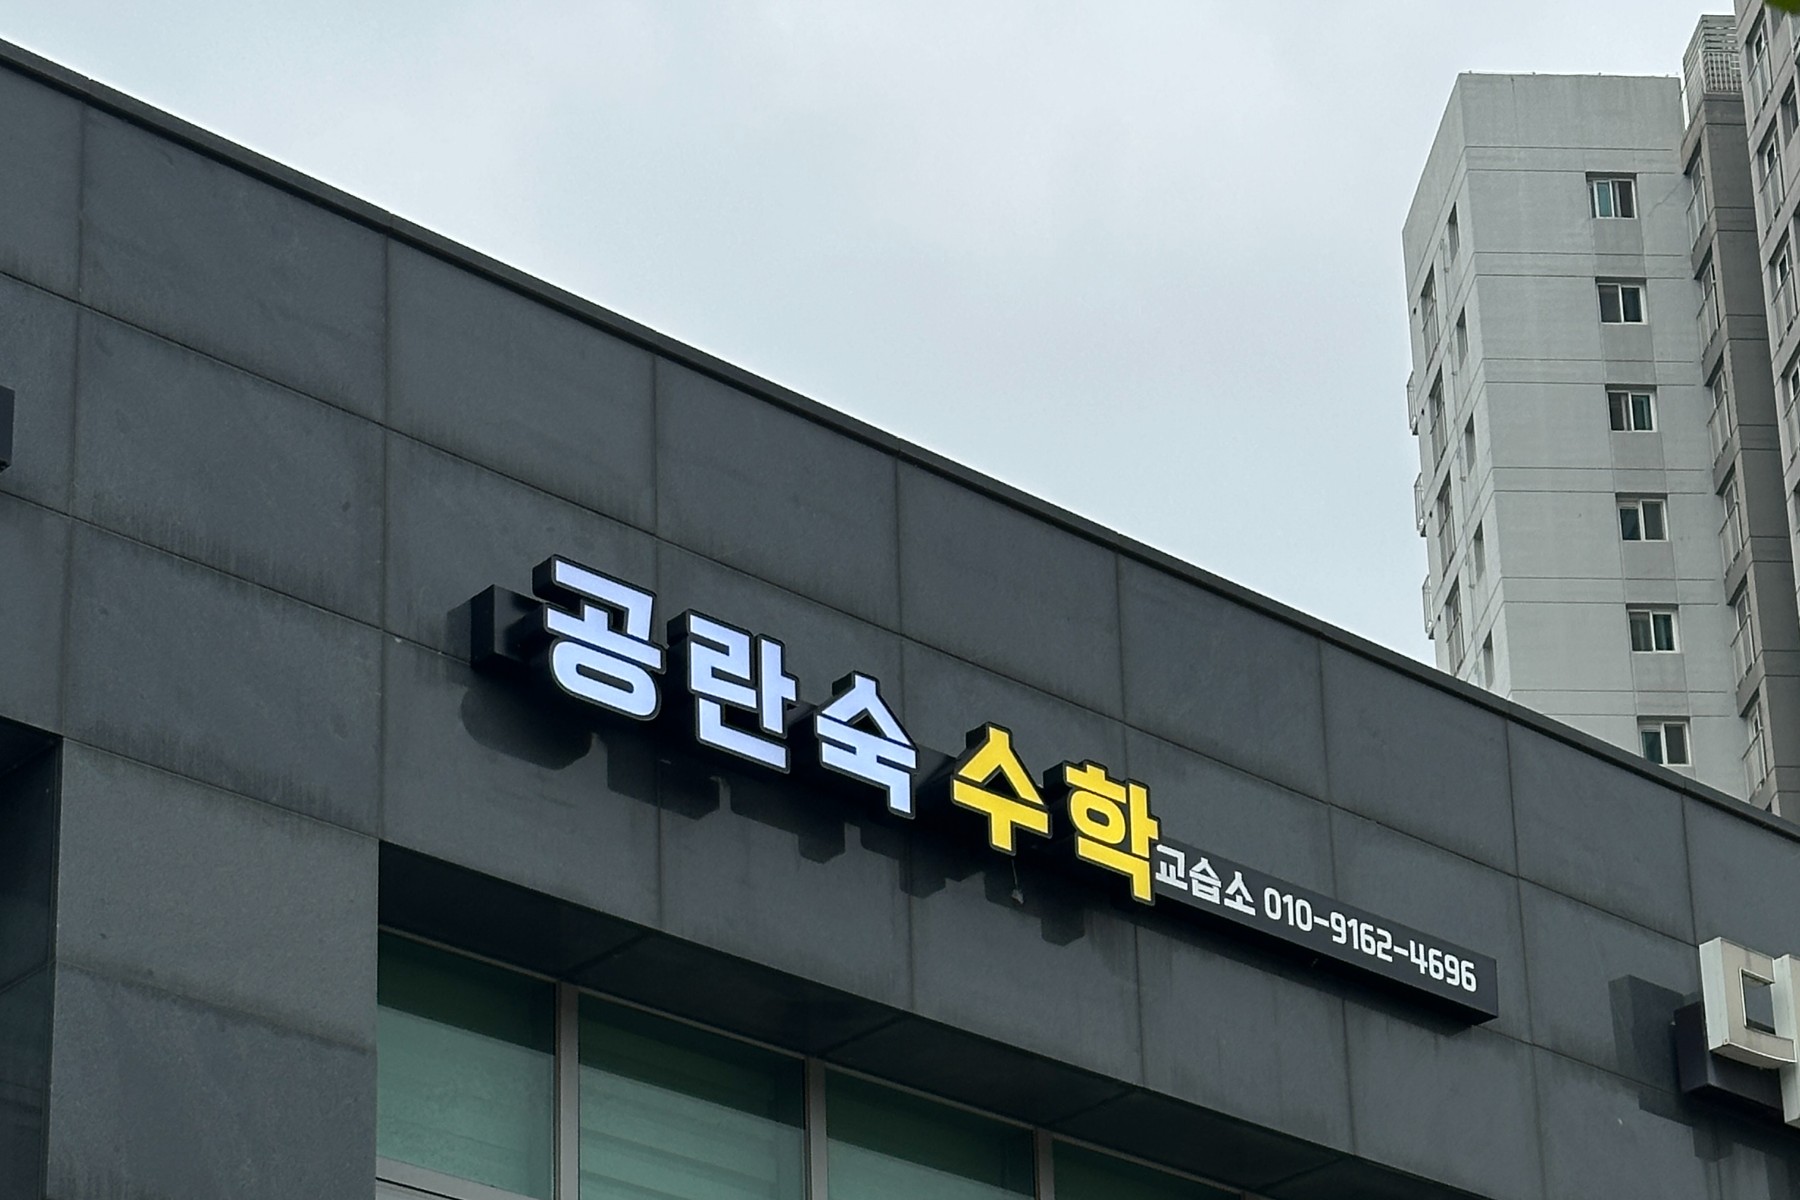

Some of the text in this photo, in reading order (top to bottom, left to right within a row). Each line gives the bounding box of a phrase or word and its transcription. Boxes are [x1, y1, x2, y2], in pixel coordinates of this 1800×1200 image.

[546, 559, 1159, 901] 공란숙 수학
[1155, 843, 1477, 992] 교습소 010-9162-4696
